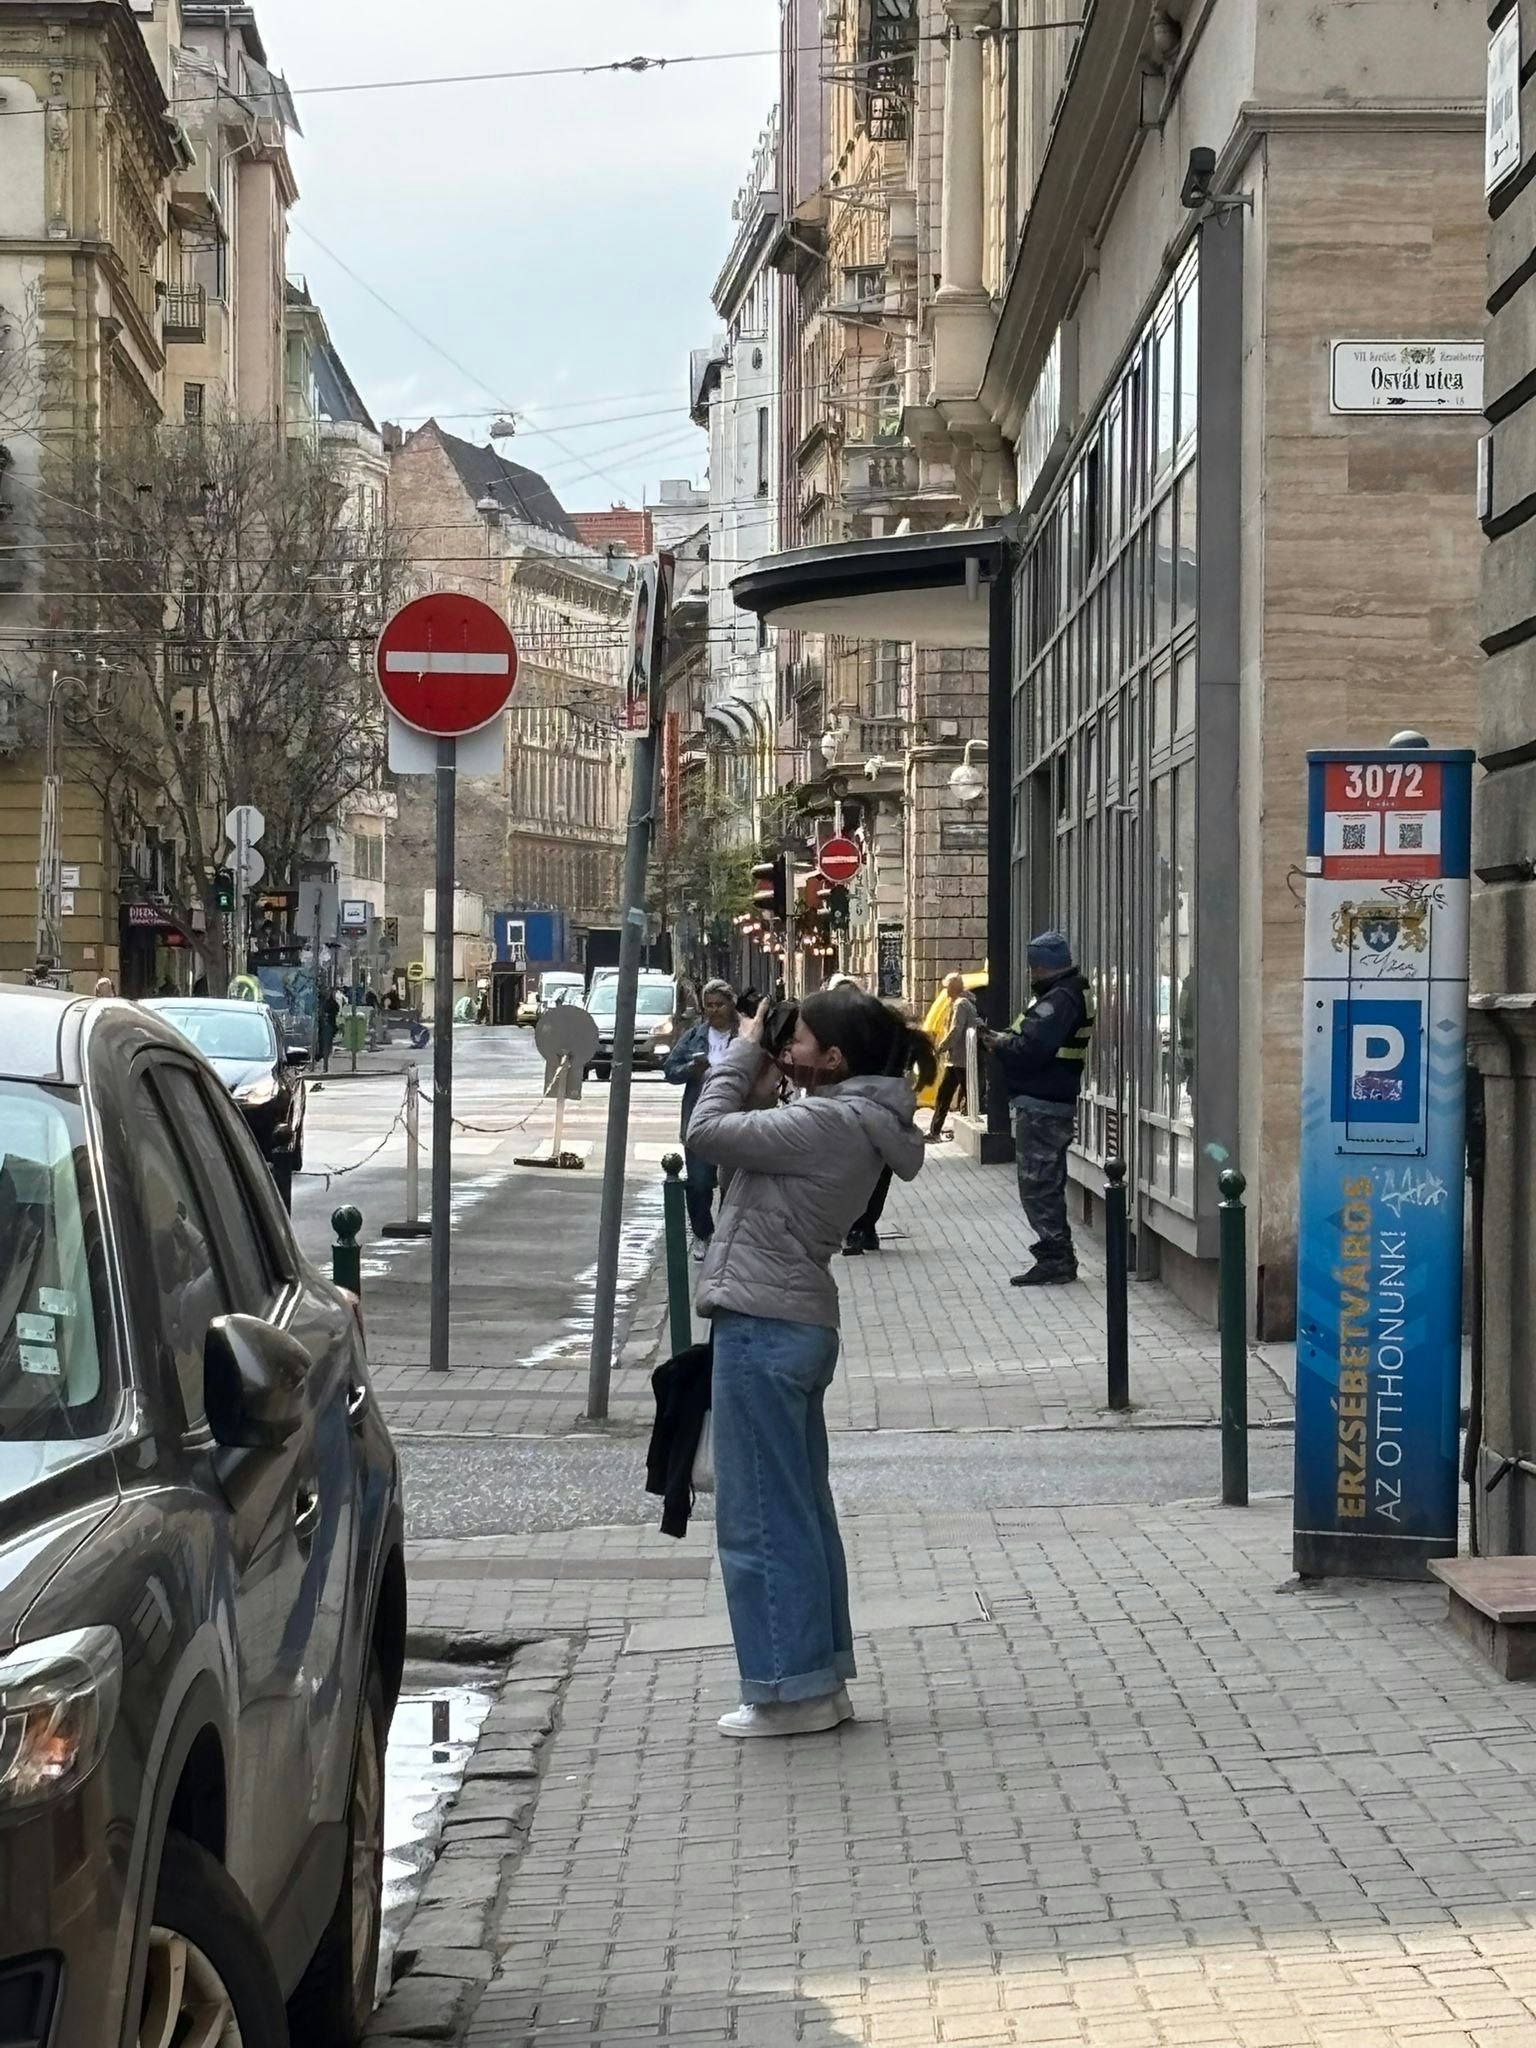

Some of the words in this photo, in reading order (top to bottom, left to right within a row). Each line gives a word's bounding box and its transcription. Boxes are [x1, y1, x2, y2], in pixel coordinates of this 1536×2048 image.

[1371, 366, 1420, 390] Osvát
[1425, 368, 1464, 390] utca
[1345, 764, 1423, 798] 3072
[1352, 1024, 1405, 1100] P
[1330, 1175, 1373, 1517] ERZSÉBETVÁROS
[1376, 1231, 1406, 1466] OTTHONUNK!
[1375, 1478, 1401, 1523] AZ
